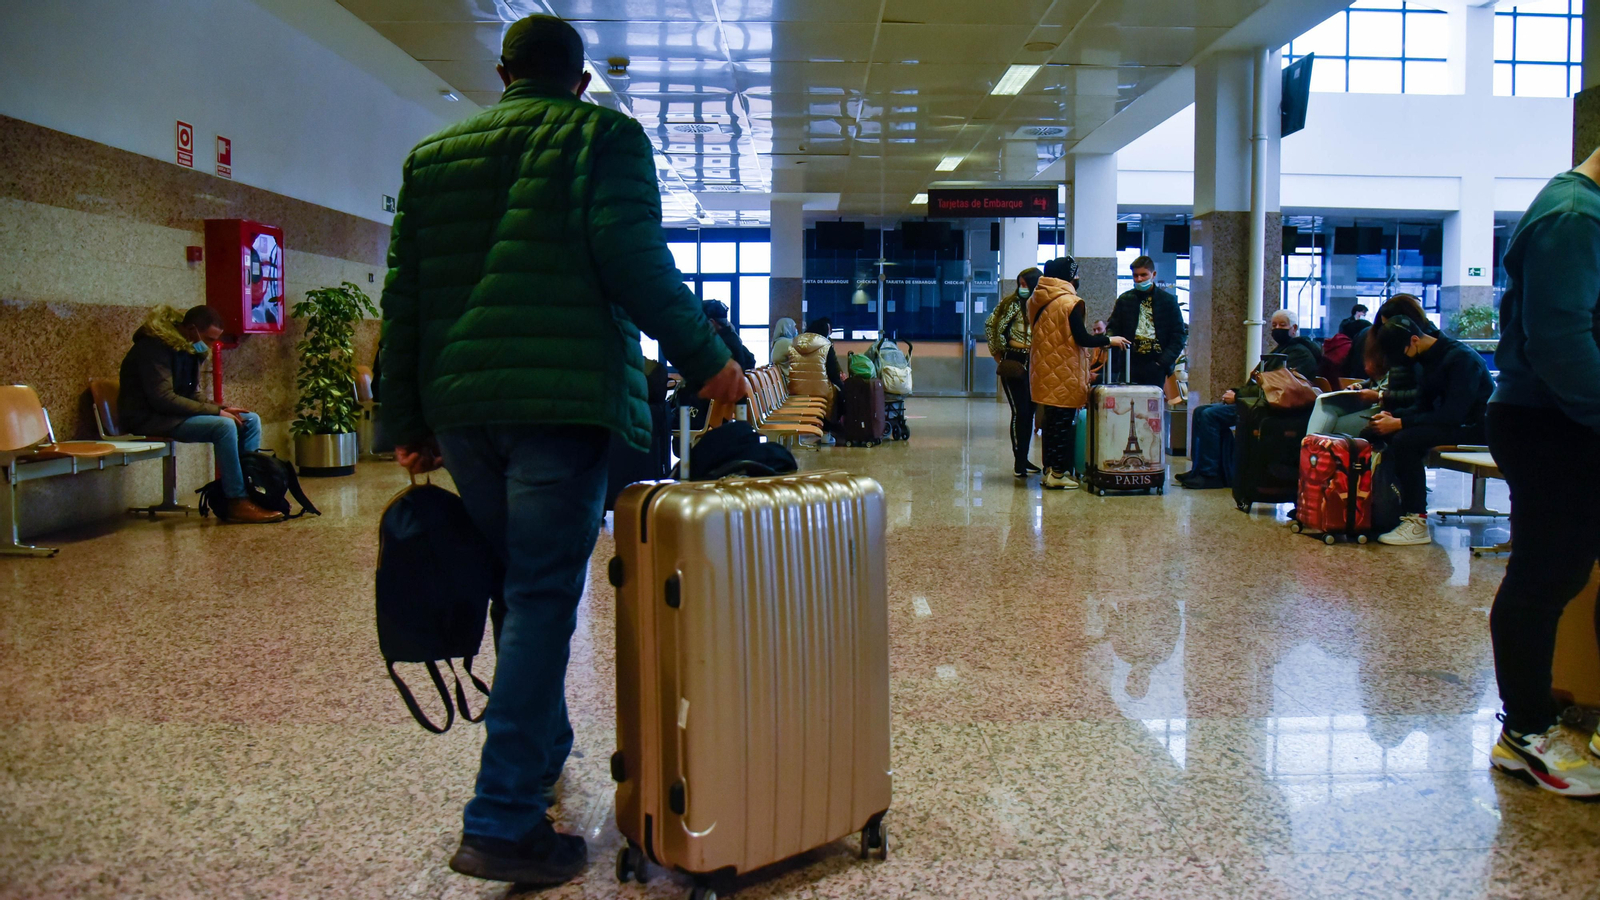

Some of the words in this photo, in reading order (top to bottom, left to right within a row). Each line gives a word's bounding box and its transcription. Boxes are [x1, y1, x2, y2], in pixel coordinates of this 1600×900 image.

[938, 198, 970, 210] Tarjetas
[971, 198, 981, 208] de
[983, 198, 1023, 209] Embarque
[1115, 475, 1151, 485] PARIS
